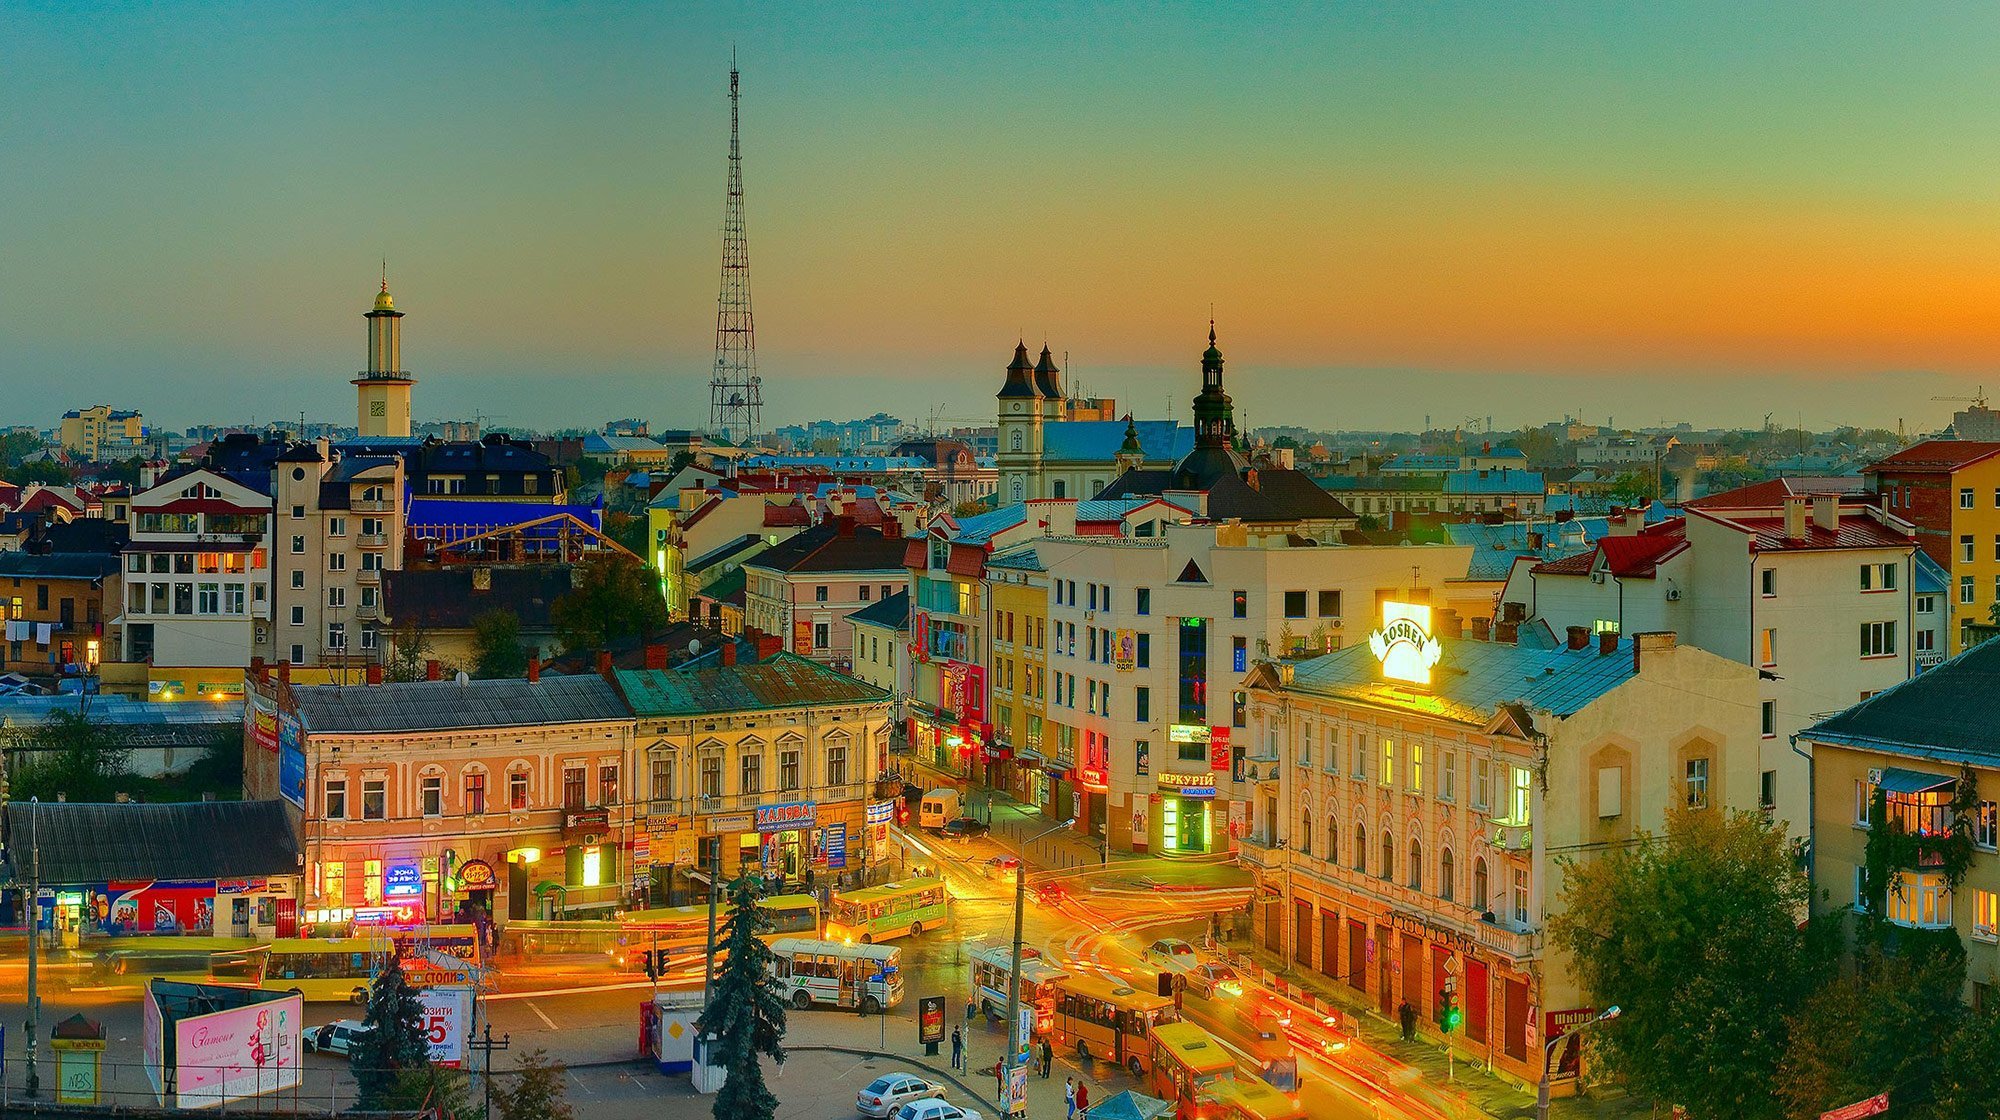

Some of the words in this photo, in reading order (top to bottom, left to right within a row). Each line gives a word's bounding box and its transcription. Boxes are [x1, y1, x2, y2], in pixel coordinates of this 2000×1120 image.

[1383, 623, 1425, 652] ROSHEN
[1158, 772, 1215, 786] МЕРКУРІЙ
[425, 967, 457, 983] СТОЛИ
[423, 1007, 453, 1016] ОЗИТИ
[1554, 1012, 1593, 1025] Шкіря
